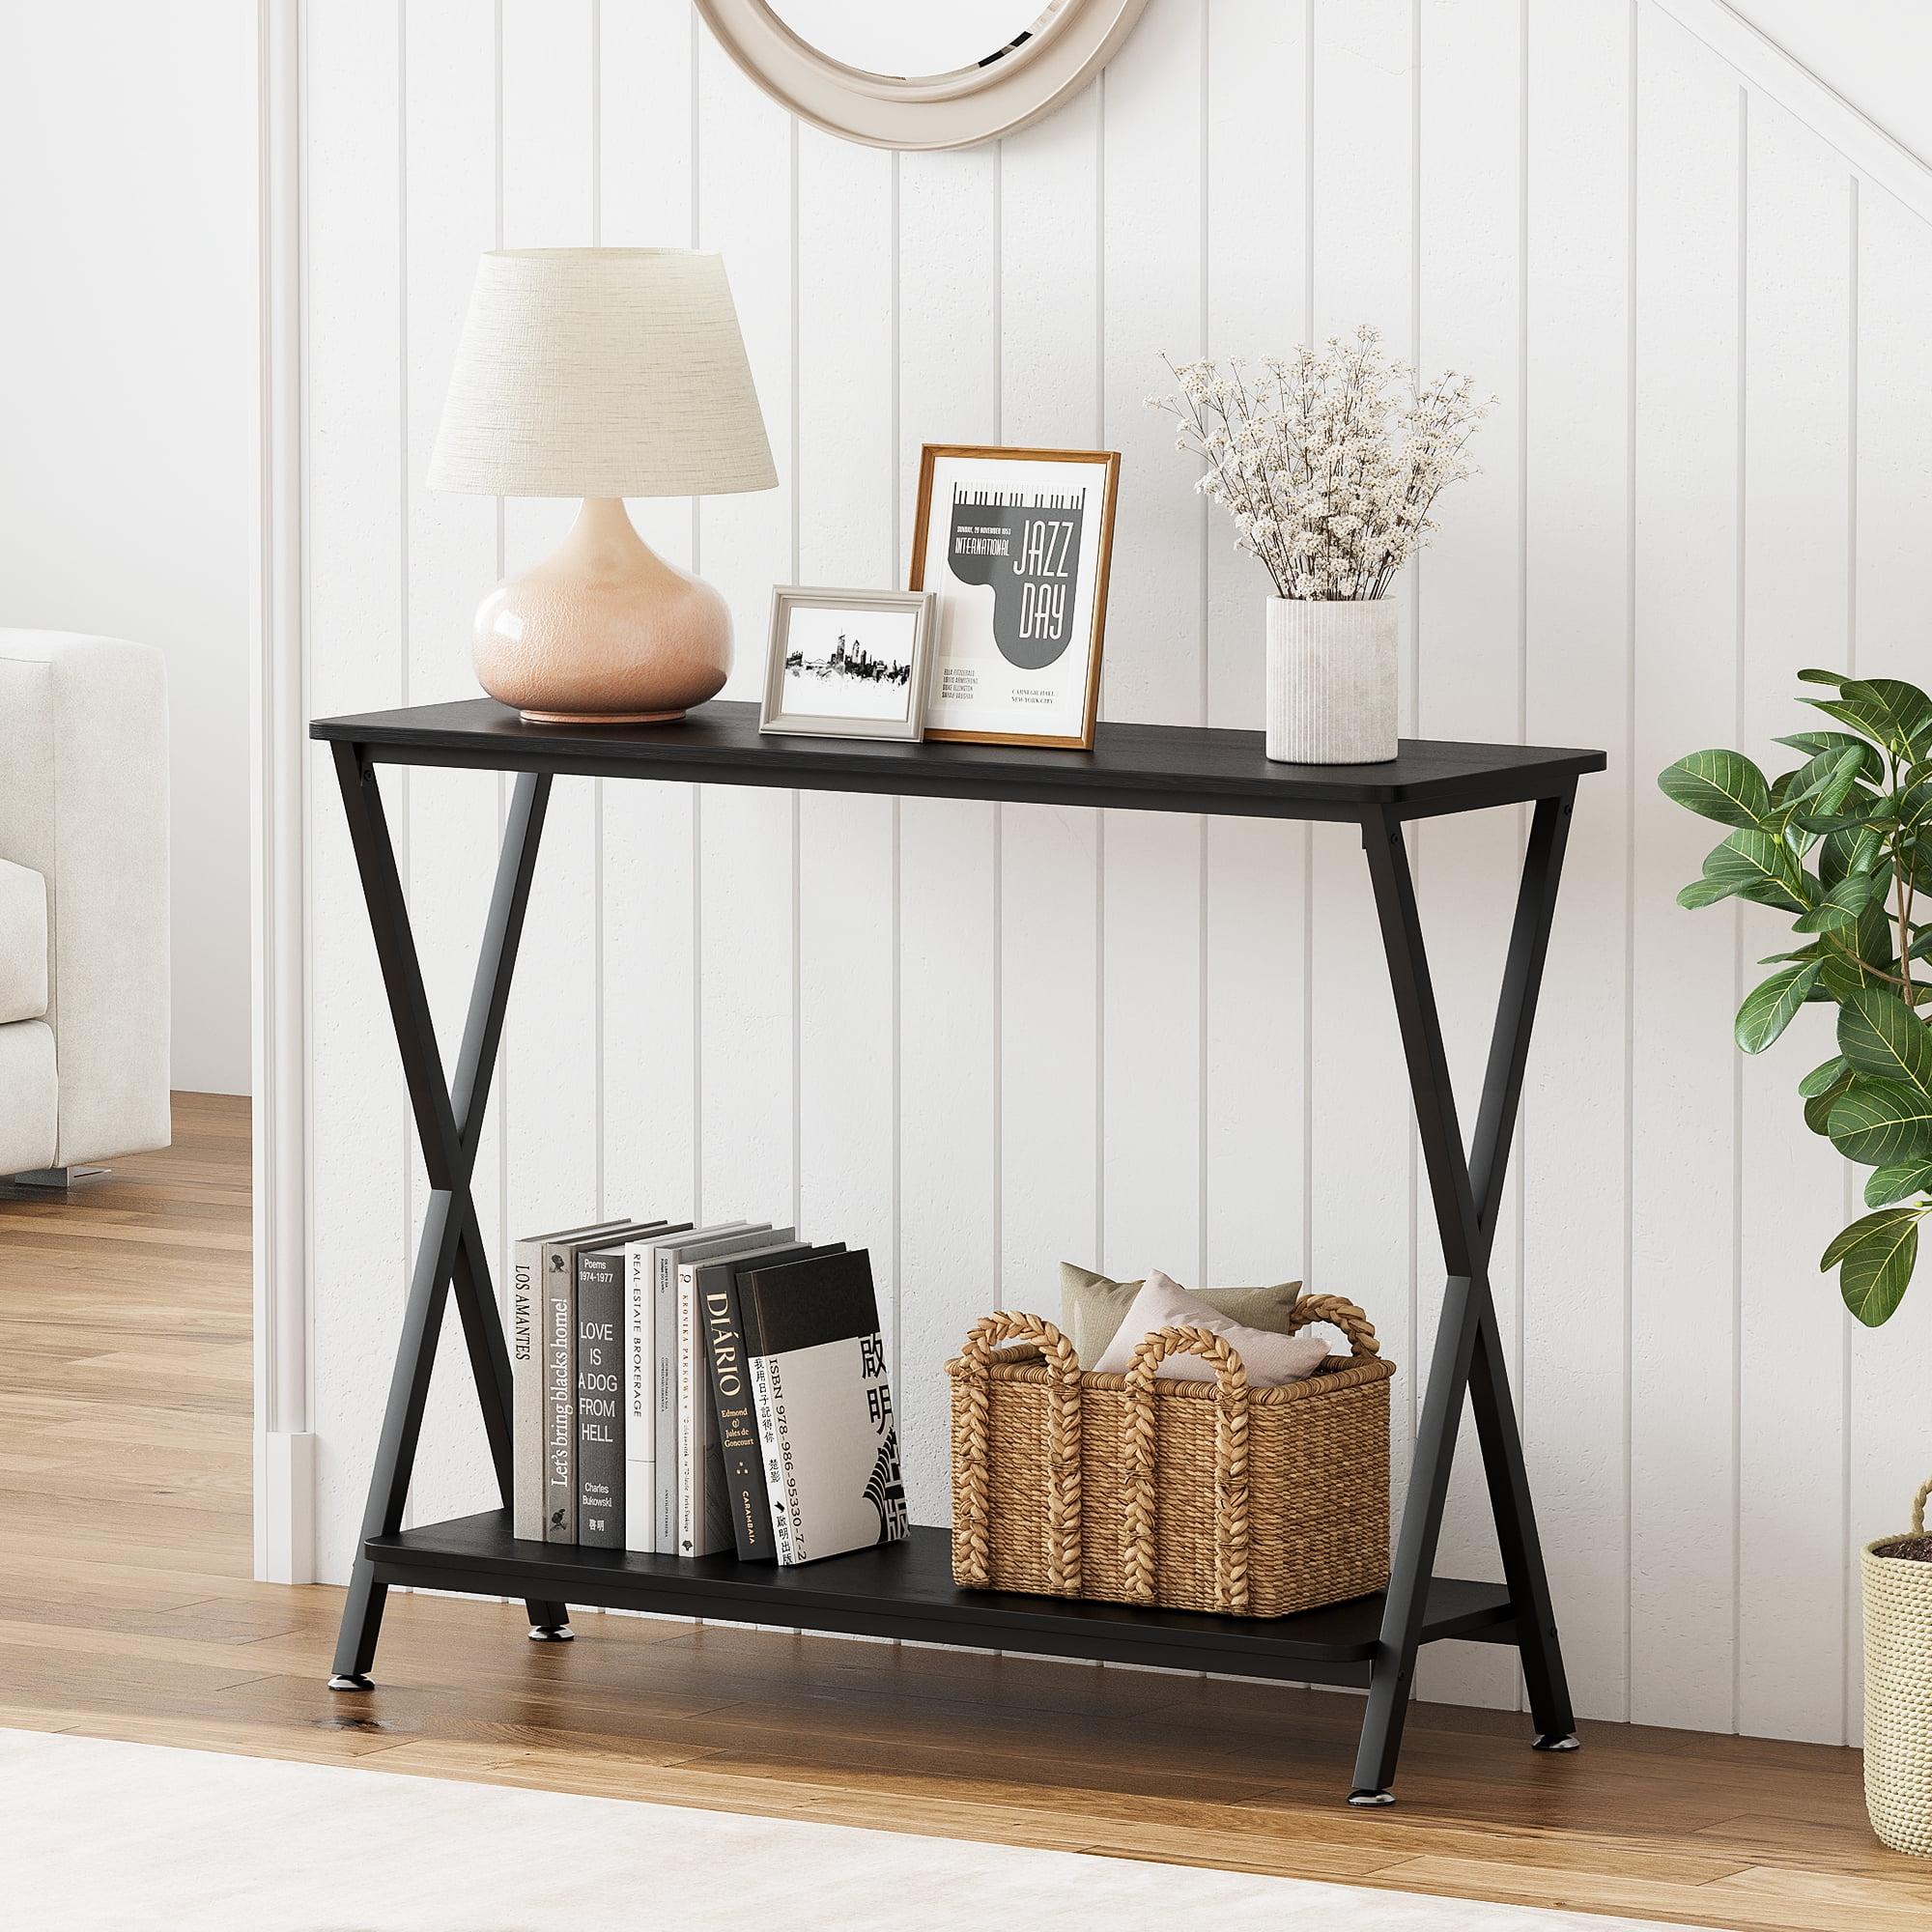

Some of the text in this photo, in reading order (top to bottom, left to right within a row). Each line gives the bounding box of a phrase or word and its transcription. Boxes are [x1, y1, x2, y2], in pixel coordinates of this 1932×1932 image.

[954, 537, 1009, 556] INTERNATIONAL
[1013, 520, 1074, 578] JAZZ
[1019, 582, 1065, 640] DAY
[583, 1259, 607, 1269] Poems
[580, 1271, 613, 1283] 1974-1977
[515, 1265, 530, 1360] LOS AMANTES
[551, 1298, 568, 1349] home!
[581, 1321, 613, 1341] LOVE
[633, 1254, 641, 1418] REAL-ESTATE BROKERAGE
[706, 1291, 741, 1397] DIÁRIO
[590, 1349, 602, 1365] IS
[551, 1351, 568, 1401] blacks
[579, 1373, 618, 1392] A DOG
[580, 1397, 615, 1417] FROM
[721, 1407, 748, 1418] Edmond
[551, 1403, 574, 1446] bring
[582, 1424, 613, 1442] HELL
[724, 1429, 740, 1438] Jules
[724, 1438, 754, 1448] Goncourt
[768, 1358, 808, 1561] ISBN 978-986-95330-7-2
[584, 1482, 610, 1493] Charles
[582, 1494, 612, 1507] Bukowski
[742, 1491, 755, 1546] CARAMBAIA
